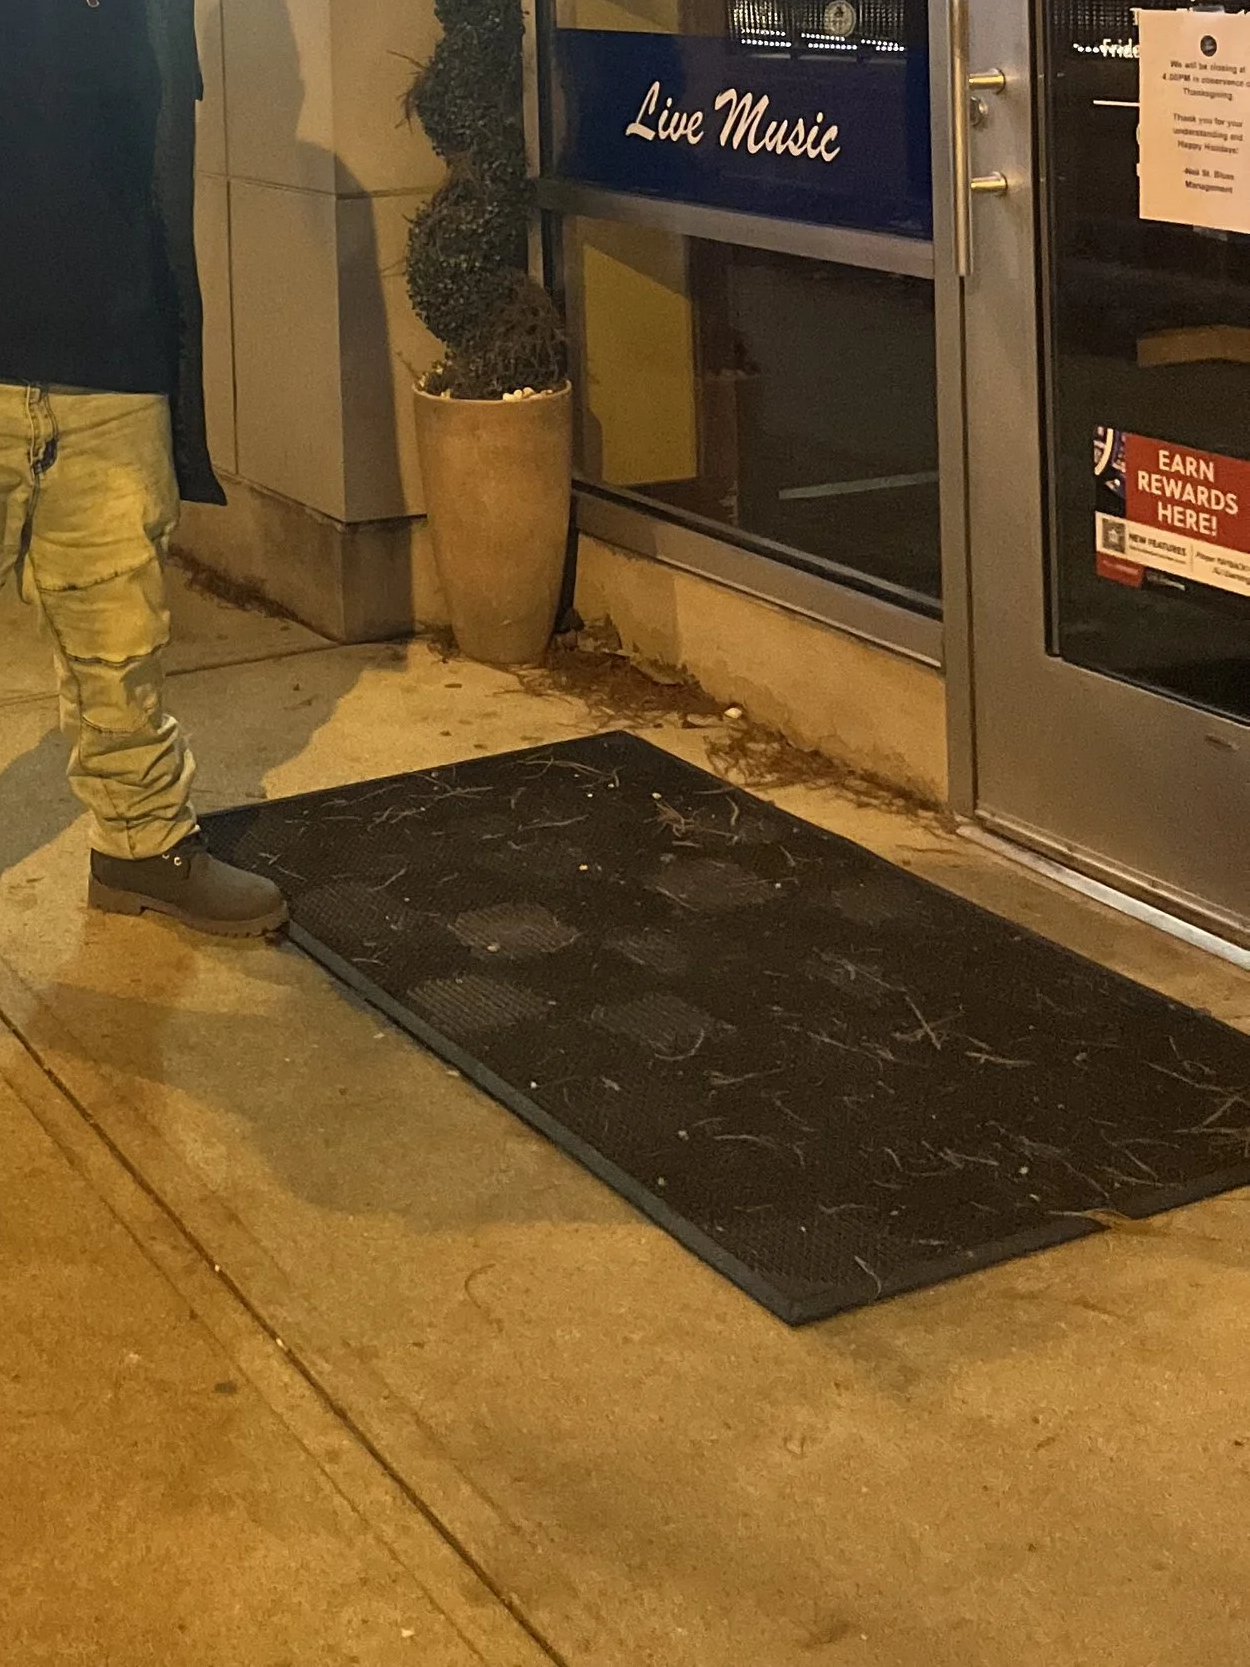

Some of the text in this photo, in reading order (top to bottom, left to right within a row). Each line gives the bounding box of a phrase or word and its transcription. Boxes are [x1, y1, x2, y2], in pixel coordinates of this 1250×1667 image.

[1170, 60, 1246, 75] We will be closing at
[1201, 77, 1244, 87] observance
[1183, 87, 1232, 101] Thanksgiving
[625, 80, 841, 162] Live Music
[1173, 113, 1243, 128] Thank you for your
[1173, 128, 1243, 141] understanding and
[1177, 140, 1201, 151] Happy
[1184, 167, 1200, 176] Neil
[1214, 170, 1234, 180] Blues
[1185, 180, 1233, 194] Management
[1158, 449, 1215, 483] EARN
[1137, 470, 1239, 515] REWARDS
[1157, 501, 1218, 537] HERE!
[1128, 533, 1147, 545] NEW
[1148, 538, 1187, 557] FEATURES
